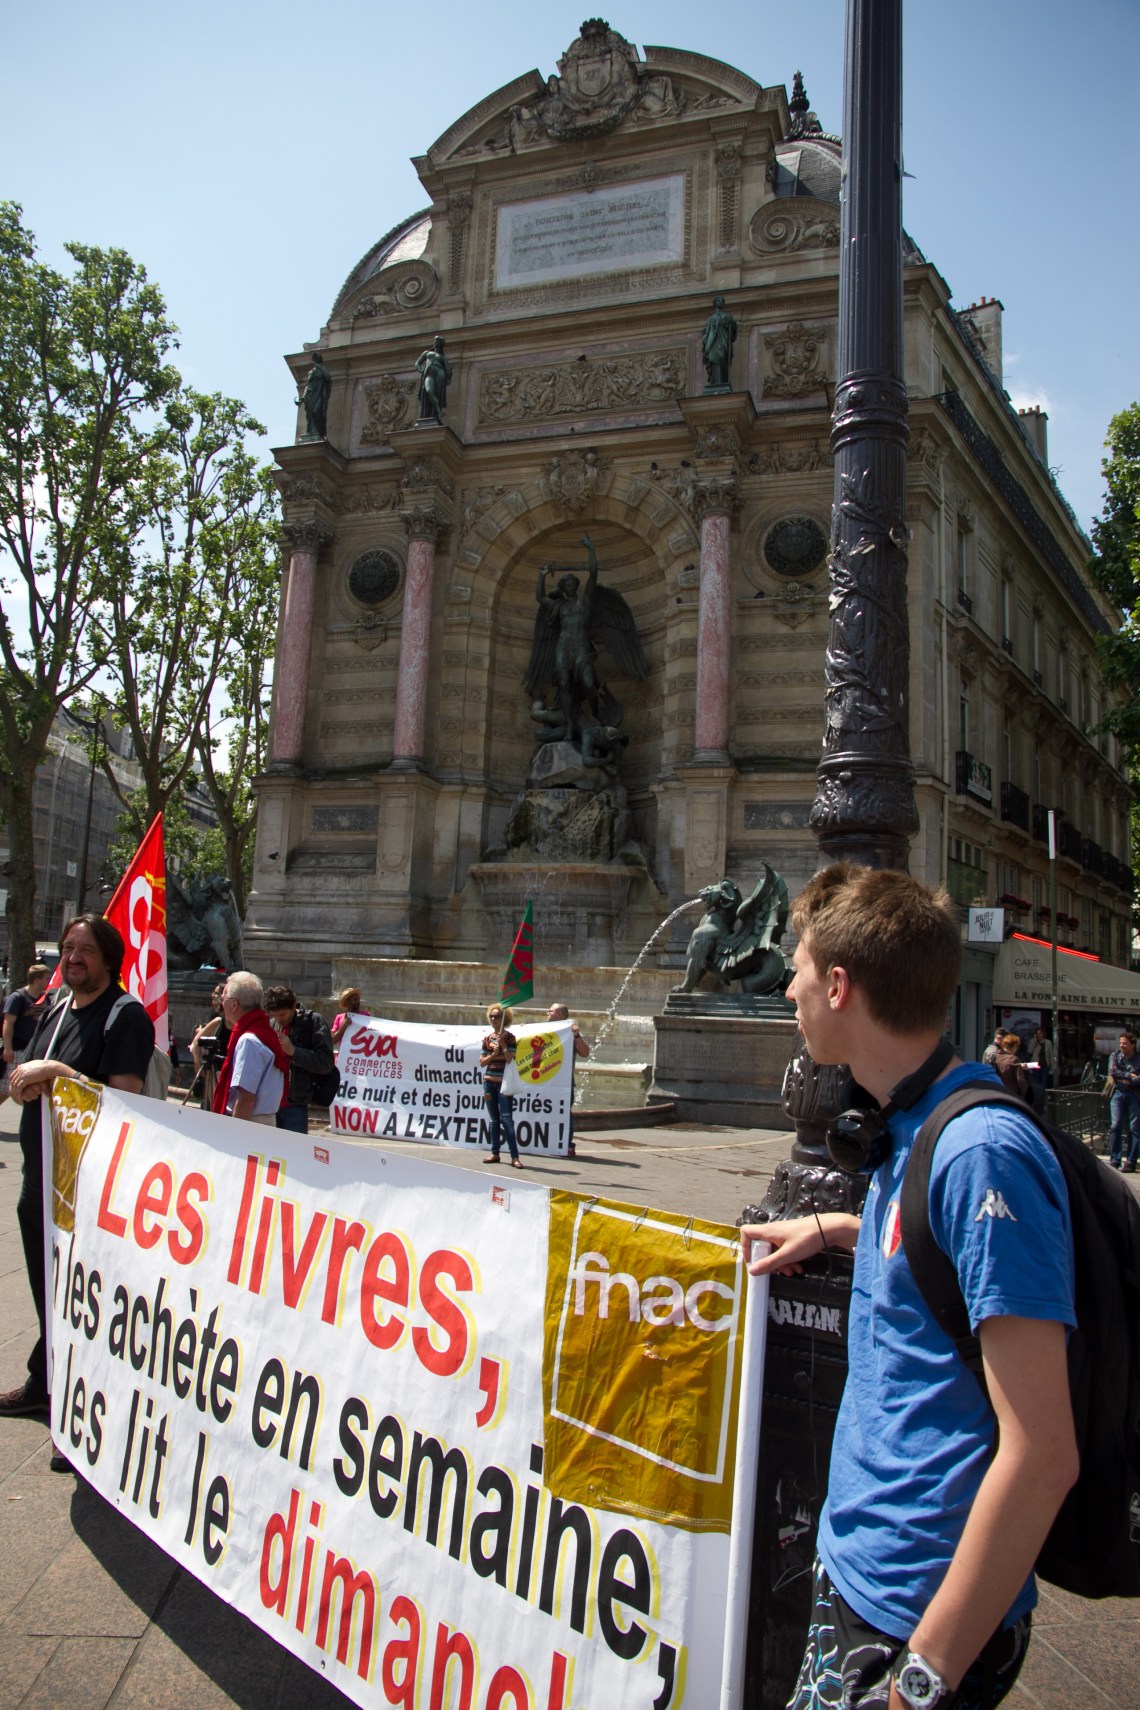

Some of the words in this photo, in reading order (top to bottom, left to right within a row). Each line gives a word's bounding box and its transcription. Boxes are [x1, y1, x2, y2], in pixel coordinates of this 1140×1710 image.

[974, 911, 990, 925] JOUR
[979, 917, 994, 930] NUIT
[1014, 958, 1040, 968] CAFE
[1014, 971, 1068, 983] BRASSEIE
[1014, 991, 1029, 1000] LA
[1031, 992, 1088, 1004] FONAINE
[1090, 995, 1127, 1006] SAINT
[445, 1044, 464, 1063] du
[414, 1063, 485, 1085] dimanch
[336, 1080, 358, 1100] de
[362, 1085, 397, 1104] nuit
[401, 1087, 418, 1106] et
[422, 1088, 451, 1108] des
[455, 1089, 486, 1114] jour
[511, 1092, 553, 1114] eriés
[334, 1104, 379, 1135] NON
[382, 1111, 397, 1137] A
[404, 1113, 550, 1149] L'EXTENON
[97, 1121, 210, 1266] Les
[226, 1153, 500, 1428] livres,
[572, 1251, 737, 1332] fnac
[63, 1232, 102, 1341] les
[108, 1276, 239, 1424] achète
[252, 1357, 321, 1472] en
[60, 1343, 107, 1466] les
[119, 1388, 168, 1519] lit
[183, 1431, 230, 1566] le
